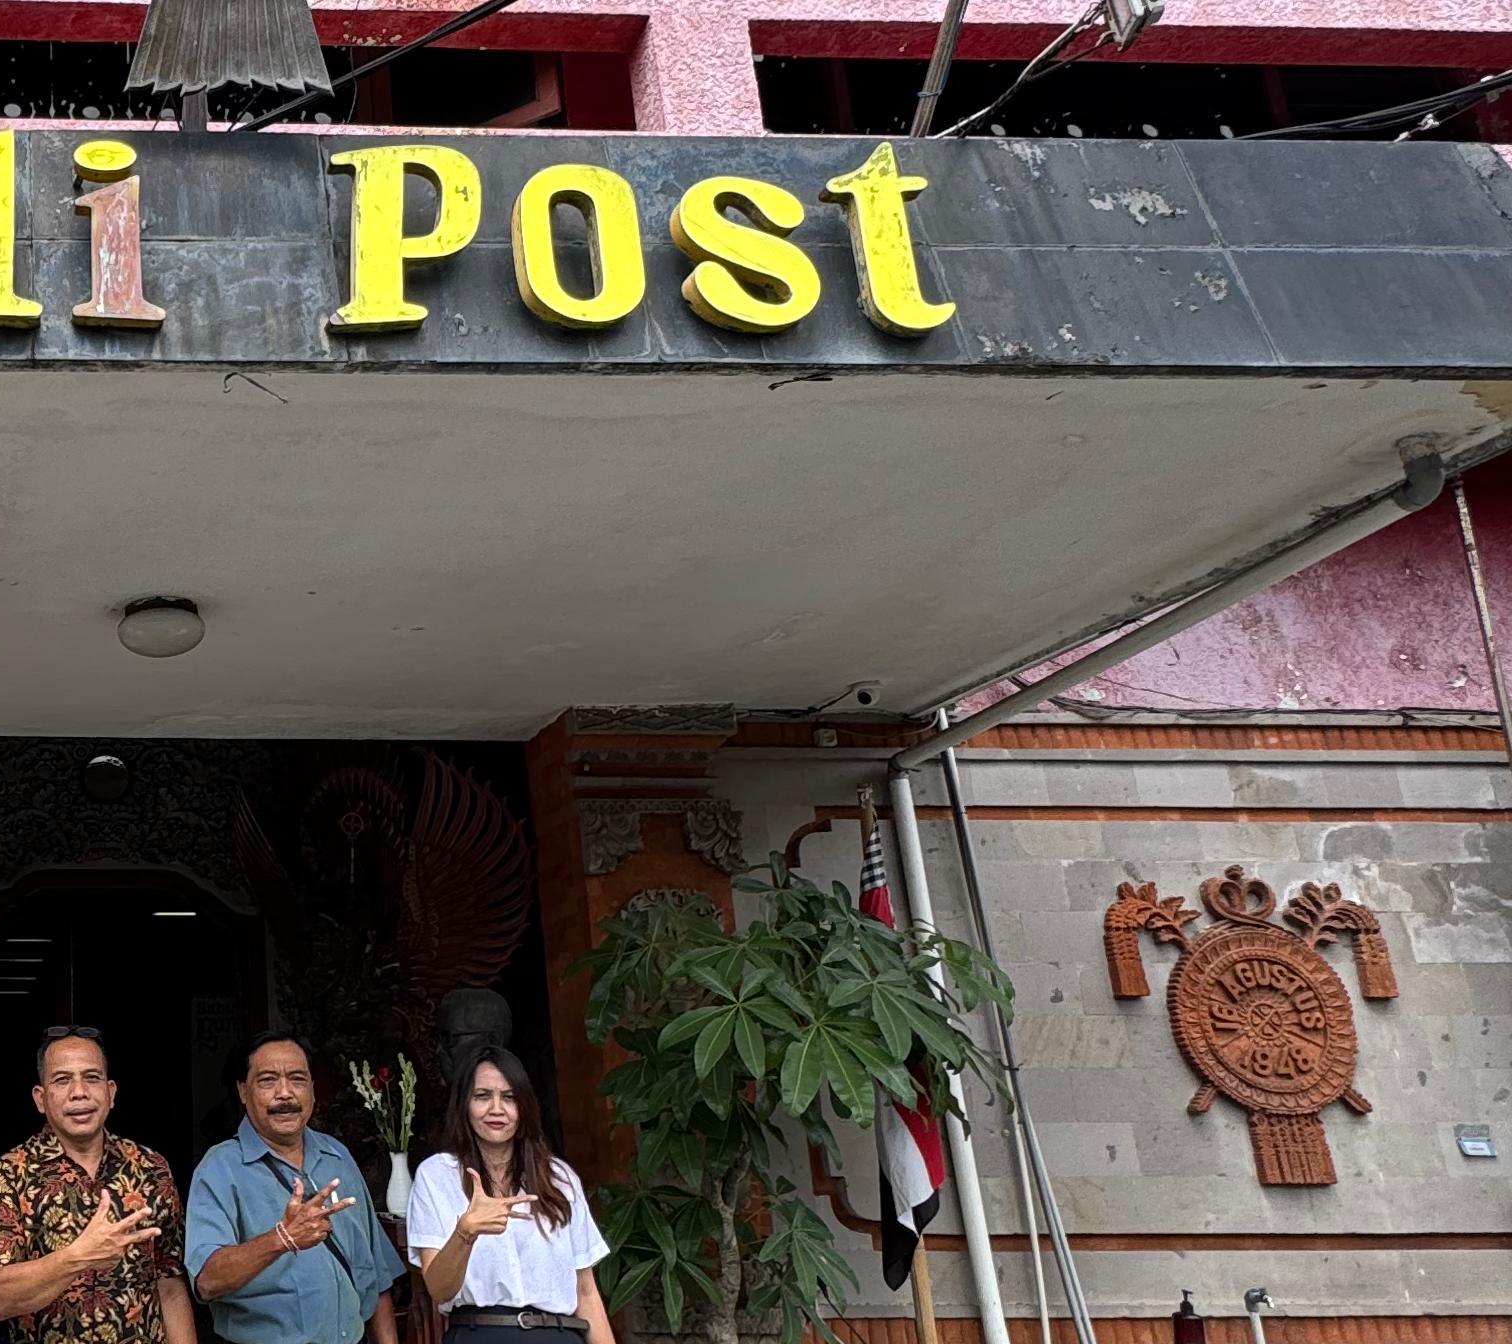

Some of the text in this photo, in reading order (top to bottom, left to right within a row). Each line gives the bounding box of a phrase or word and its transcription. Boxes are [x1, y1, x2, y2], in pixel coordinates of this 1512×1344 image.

[327, 140, 958, 339] Post
[1209, 959, 1326, 1032] 16 AGUSTUS
[1238, 1045, 1315, 1080] 1948
